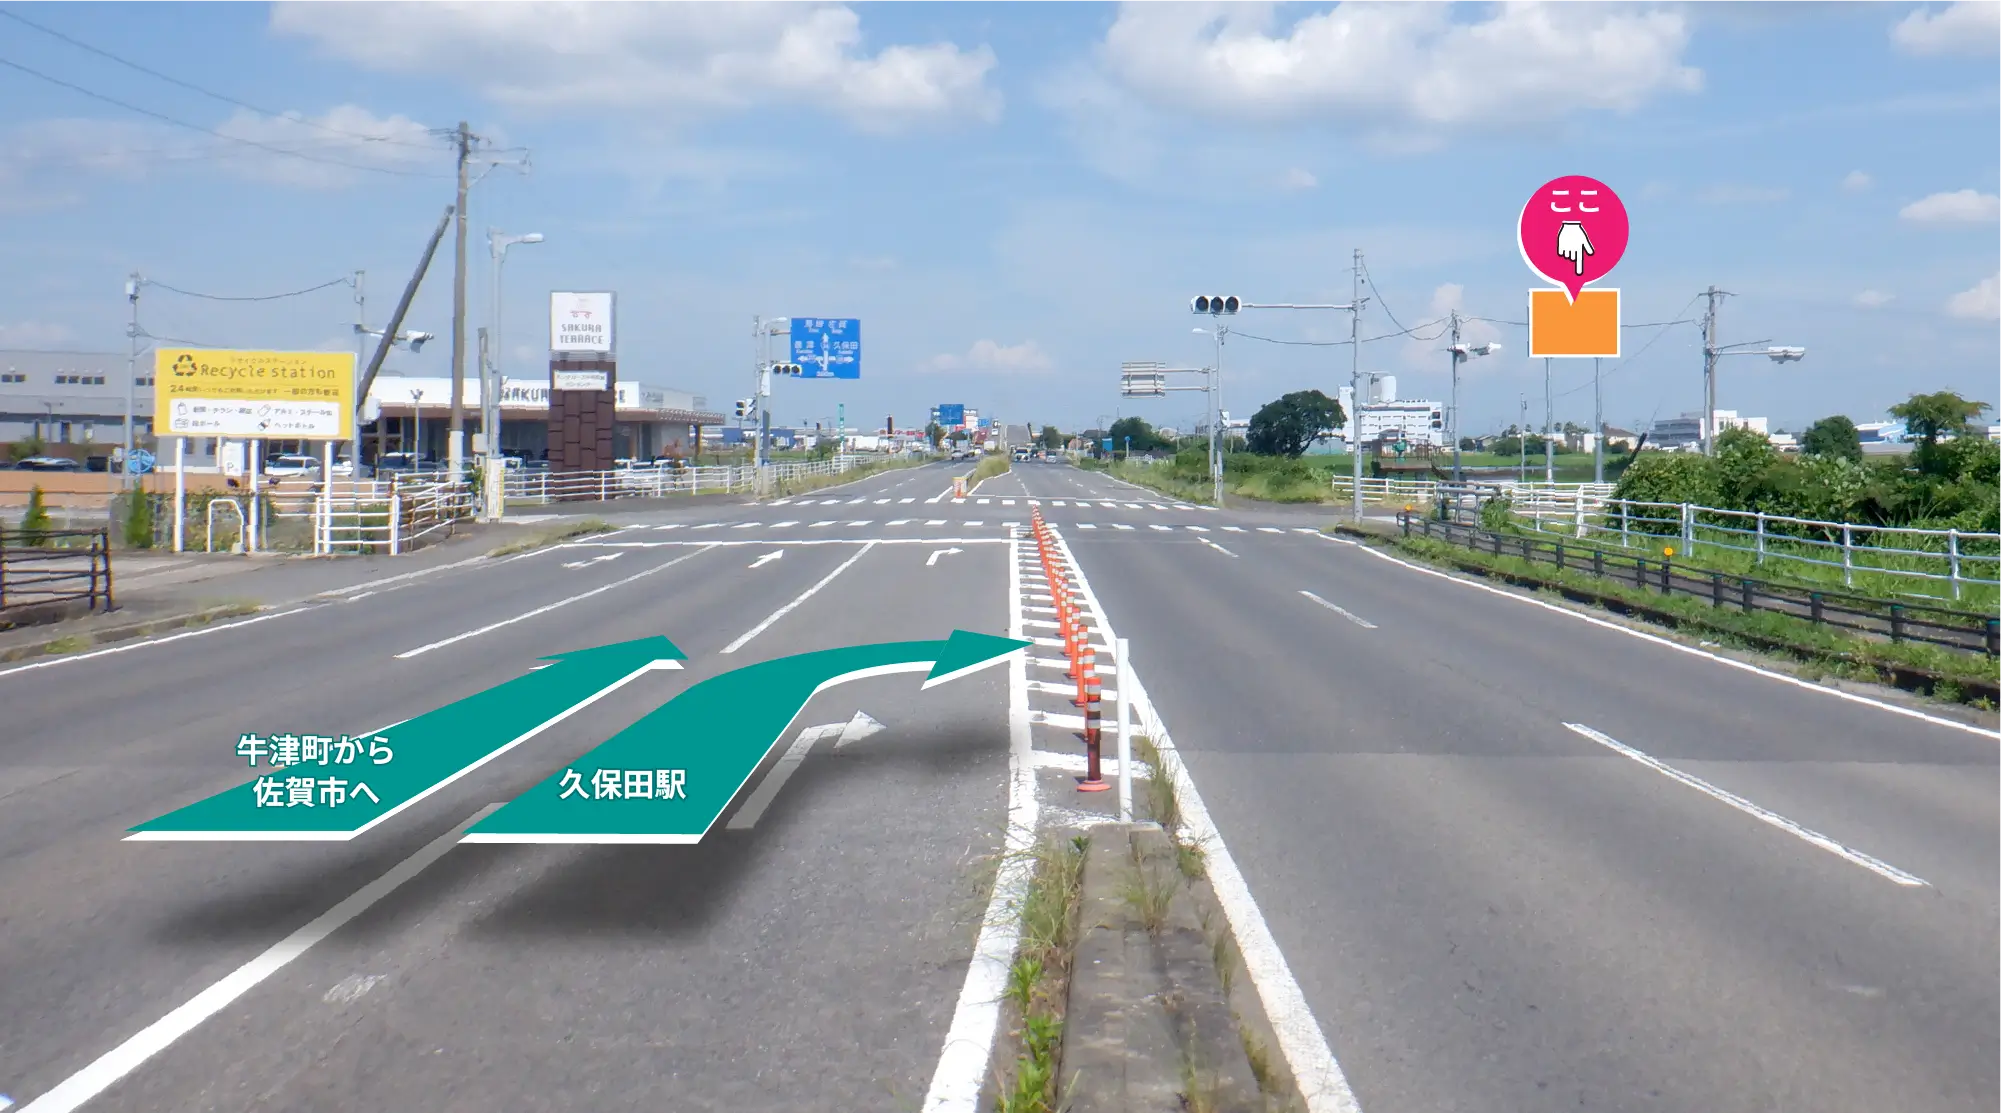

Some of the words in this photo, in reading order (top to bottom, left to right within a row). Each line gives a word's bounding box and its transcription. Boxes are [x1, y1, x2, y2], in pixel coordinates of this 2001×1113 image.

[561, 323, 602, 333] SAKURA
[560, 334, 604, 345] TERRACE
[200, 364, 266, 380] Recycle
[272, 364, 336, 379] station
